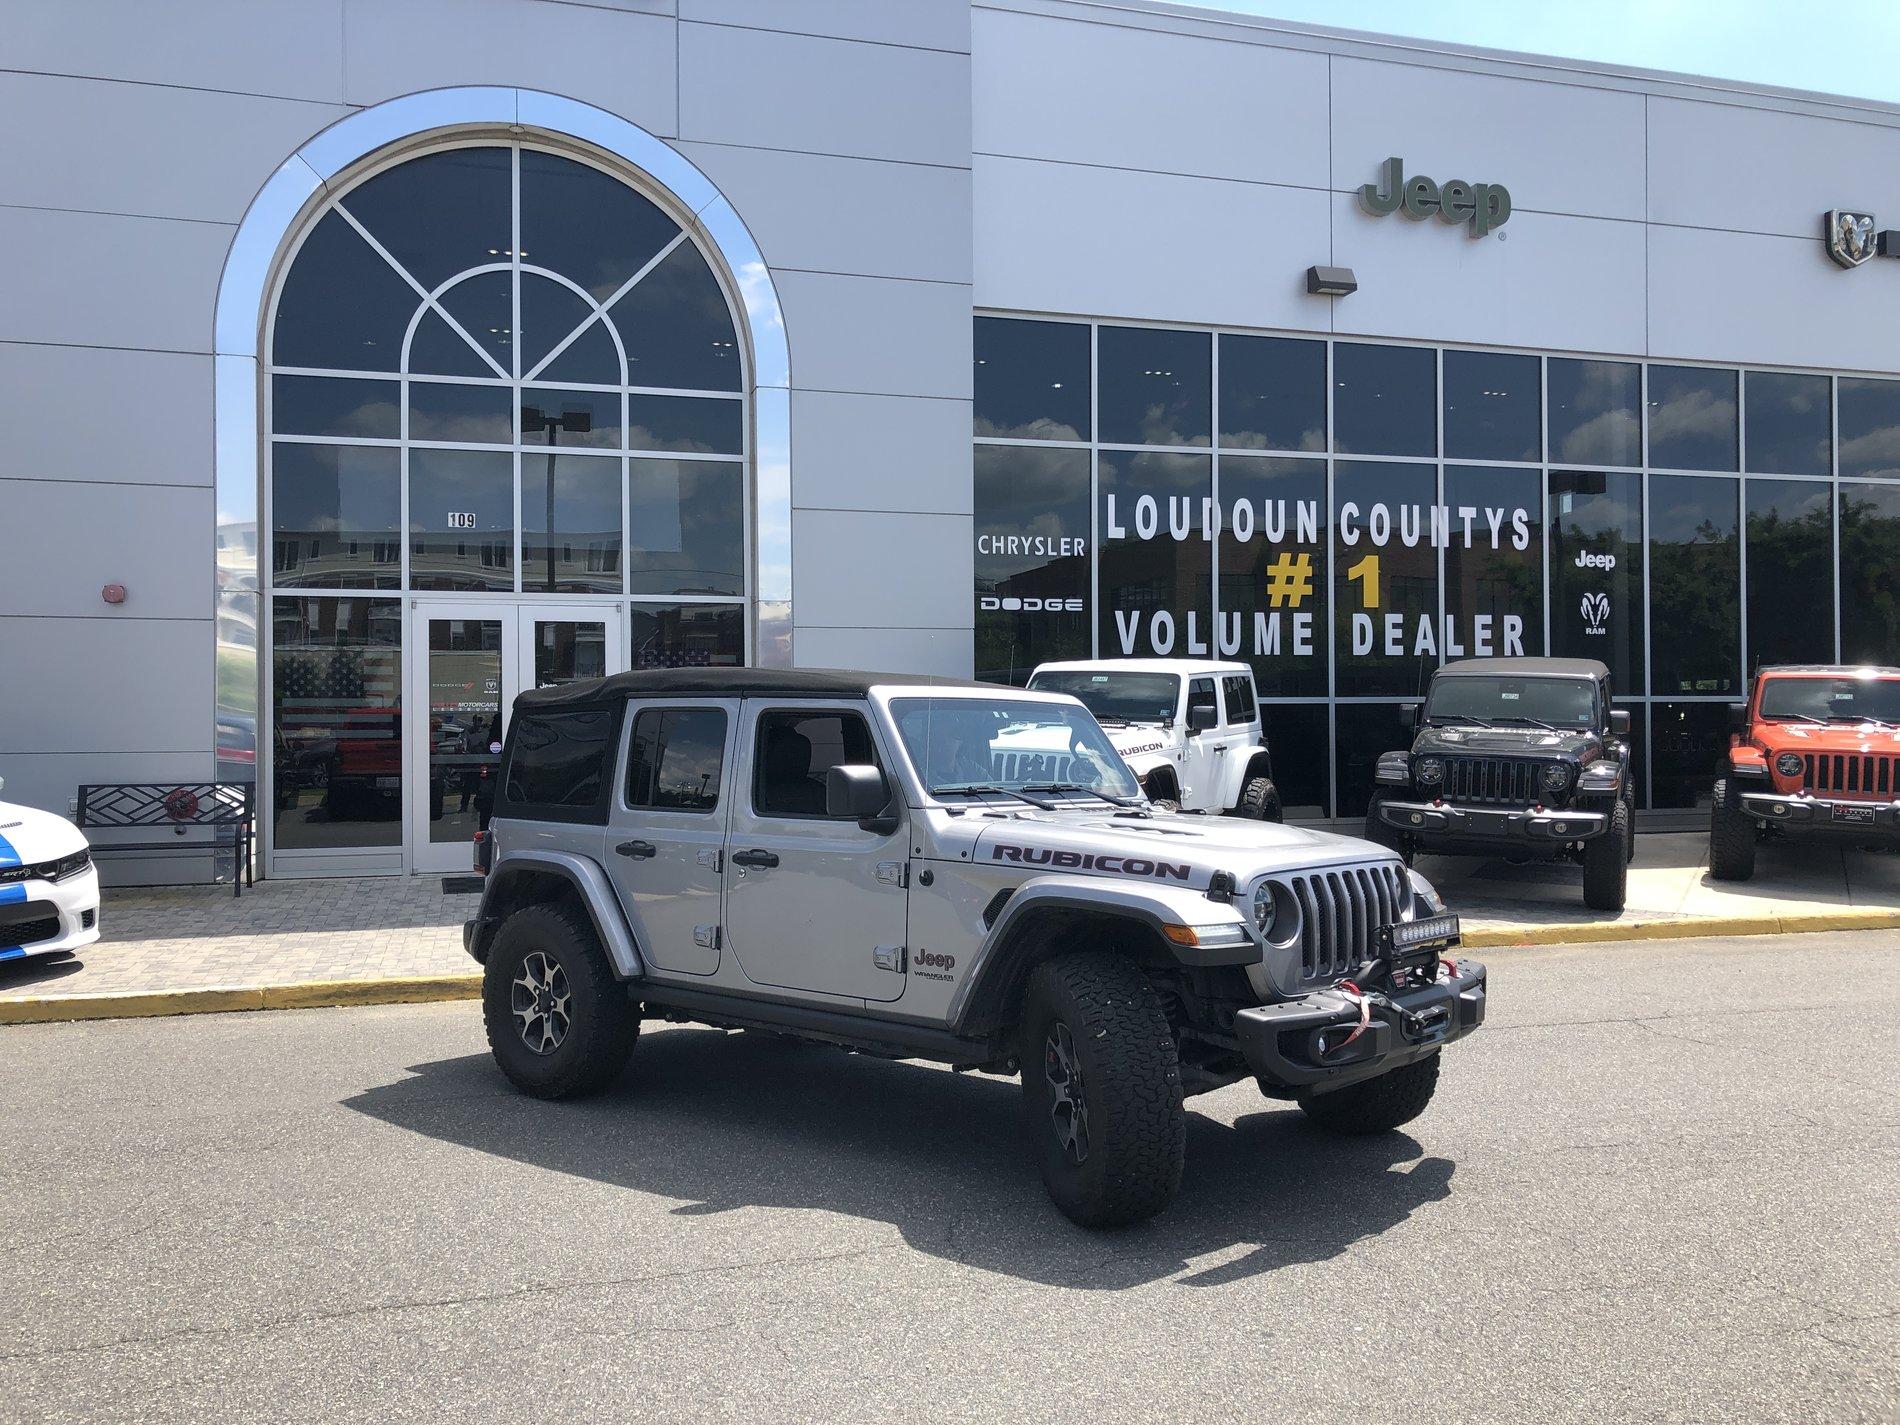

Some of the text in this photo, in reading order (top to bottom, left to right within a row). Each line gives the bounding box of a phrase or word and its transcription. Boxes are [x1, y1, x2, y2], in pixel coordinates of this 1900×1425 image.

[1357, 156, 1512, 239] Jeep
[450, 513, 474, 527] 109
[1107, 493, 1530, 551] LOUDOUN COUNTYS
[977, 534, 1085, 557] CHRYSLER
[1574, 549, 1616, 572] Jeep
[1266, 551, 1381, 609] # 1
[980, 597, 1083, 612] DODGE
[1114, 610, 1525, 657] VOLUME DEALER
[1585, 627, 1606, 635] RAM
[992, 844, 1192, 881] RUBICON
[914, 948, 955, 971] Jeep
